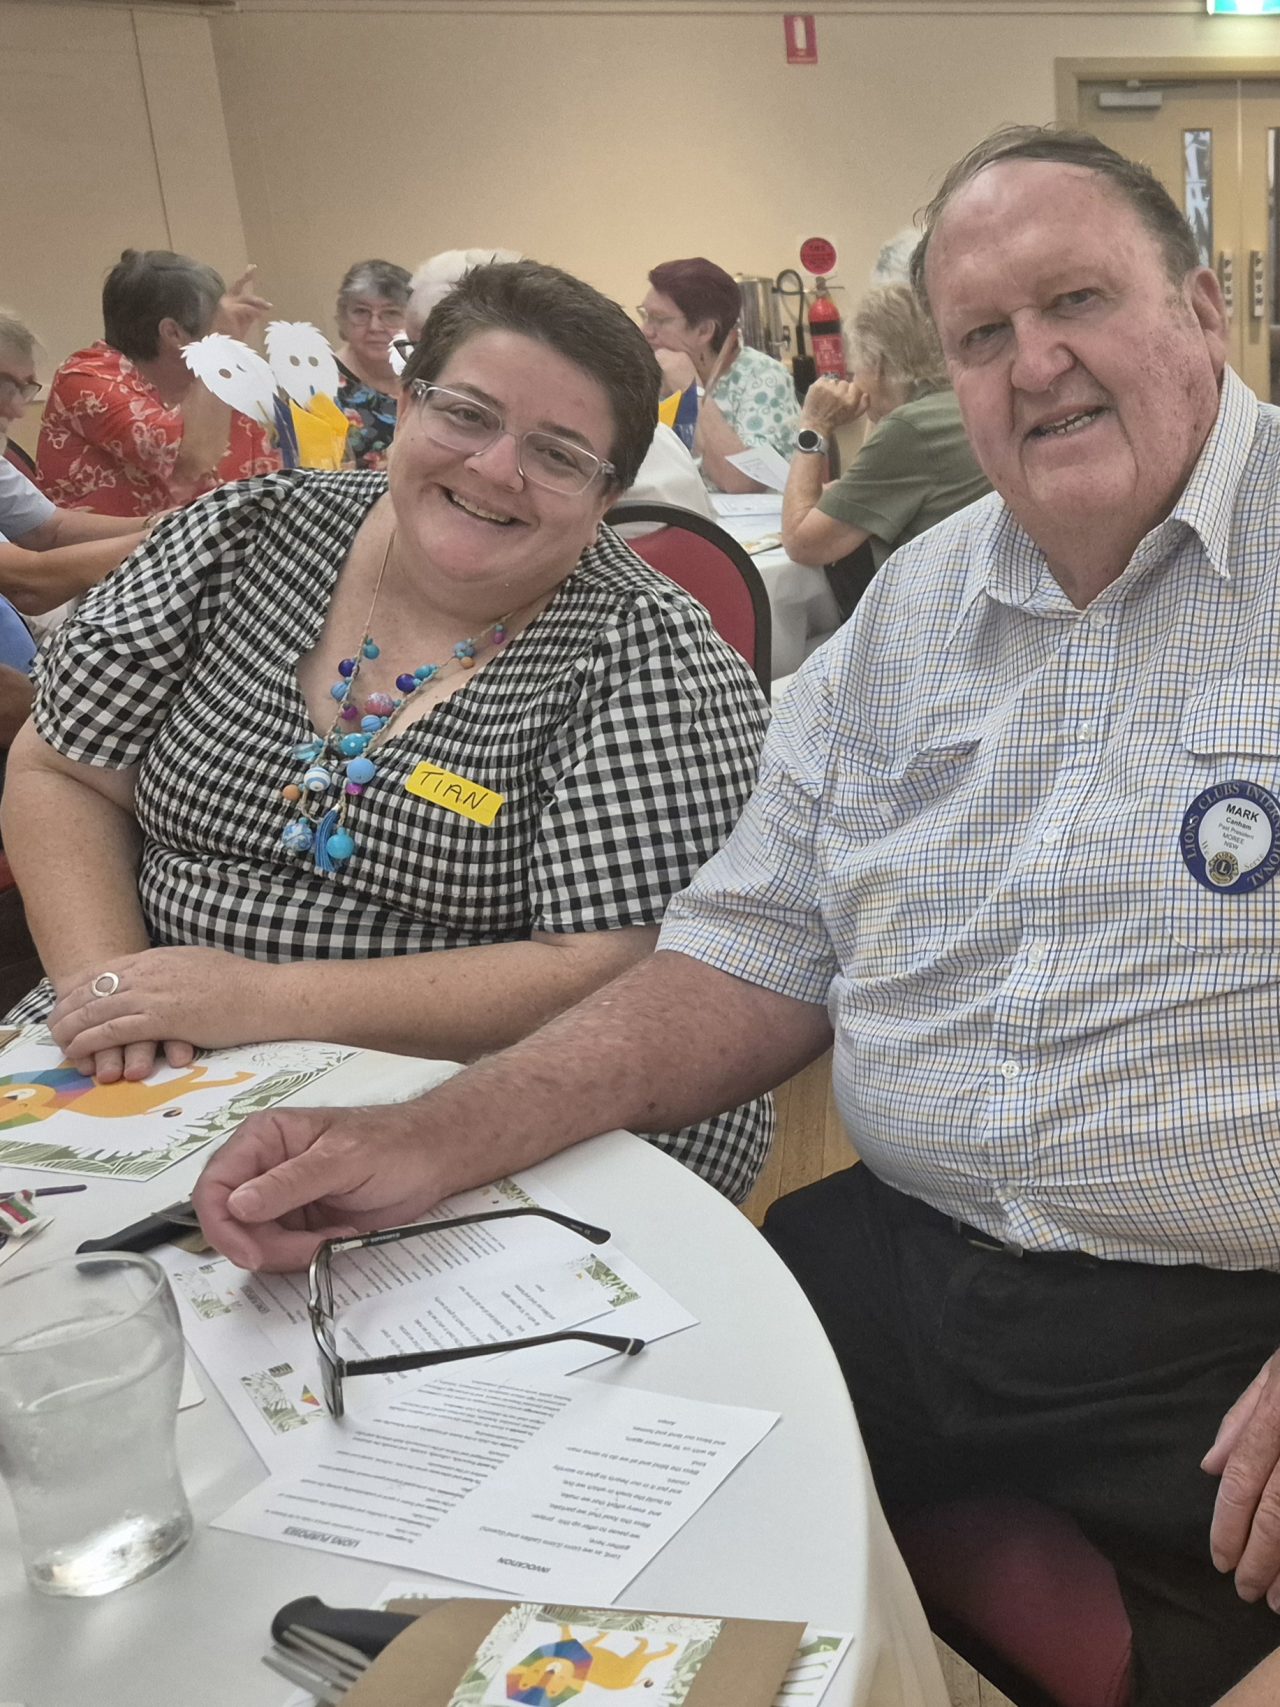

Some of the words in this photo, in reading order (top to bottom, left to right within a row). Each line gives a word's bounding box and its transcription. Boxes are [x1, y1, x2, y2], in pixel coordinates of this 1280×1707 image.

[1255, 258, 1264, 306] PUSH
[420, 770, 489, 810] TIAN
[1184, 813, 1199, 859] LIONS
[1198, 783, 1241, 811] CLUBS
[1226, 803, 1260, 823] MARK
[1225, 817, 1252, 831] Canham
[1220, 861, 1228, 875] L
[282, 1526, 334, 1543] PURPOSES
[329, 1535, 360, 1548] LIONS
[497, 1557, 551, 1573] INVOCATION
